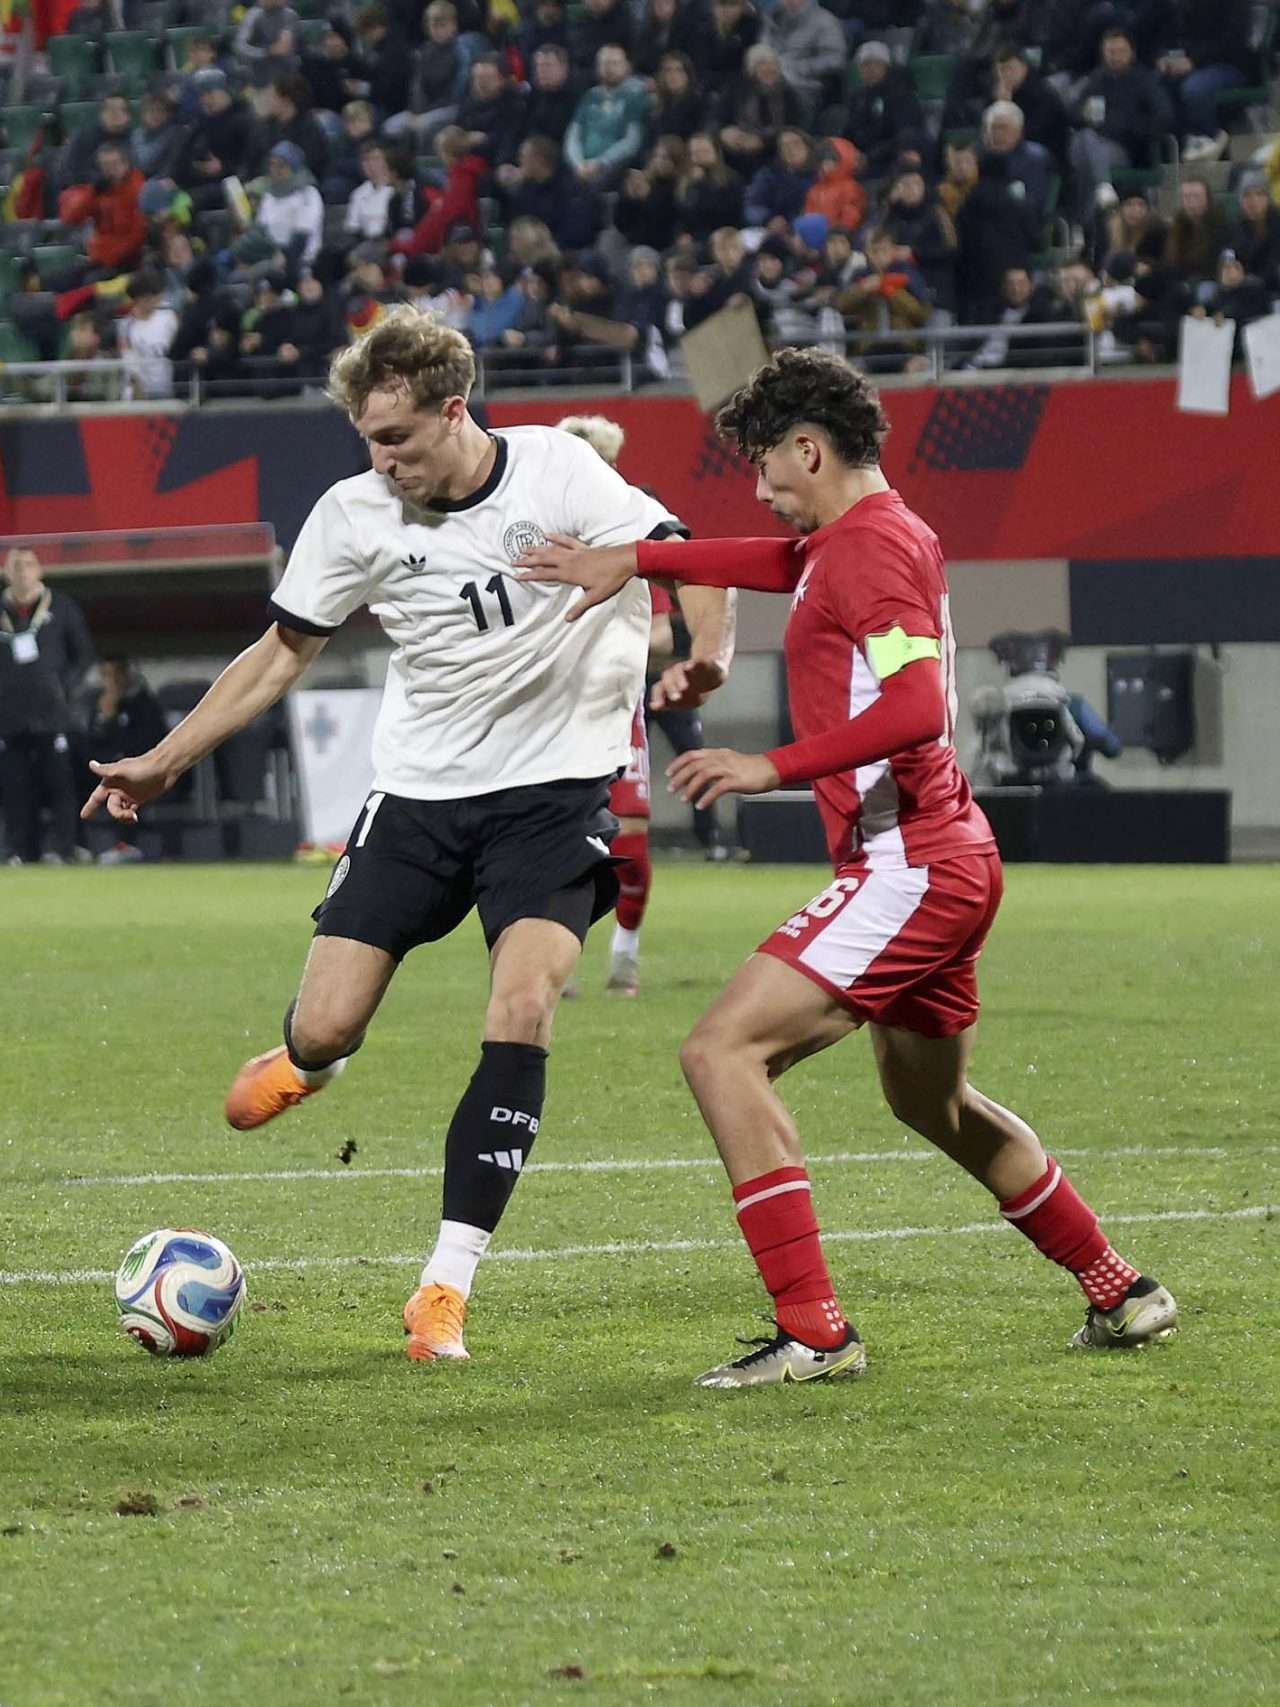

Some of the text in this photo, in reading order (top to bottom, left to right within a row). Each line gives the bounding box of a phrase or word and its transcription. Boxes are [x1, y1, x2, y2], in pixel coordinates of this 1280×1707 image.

[458, 572, 515, 632] 11
[802, 877, 860, 918] 6
[489, 1106, 540, 1134] DFB
